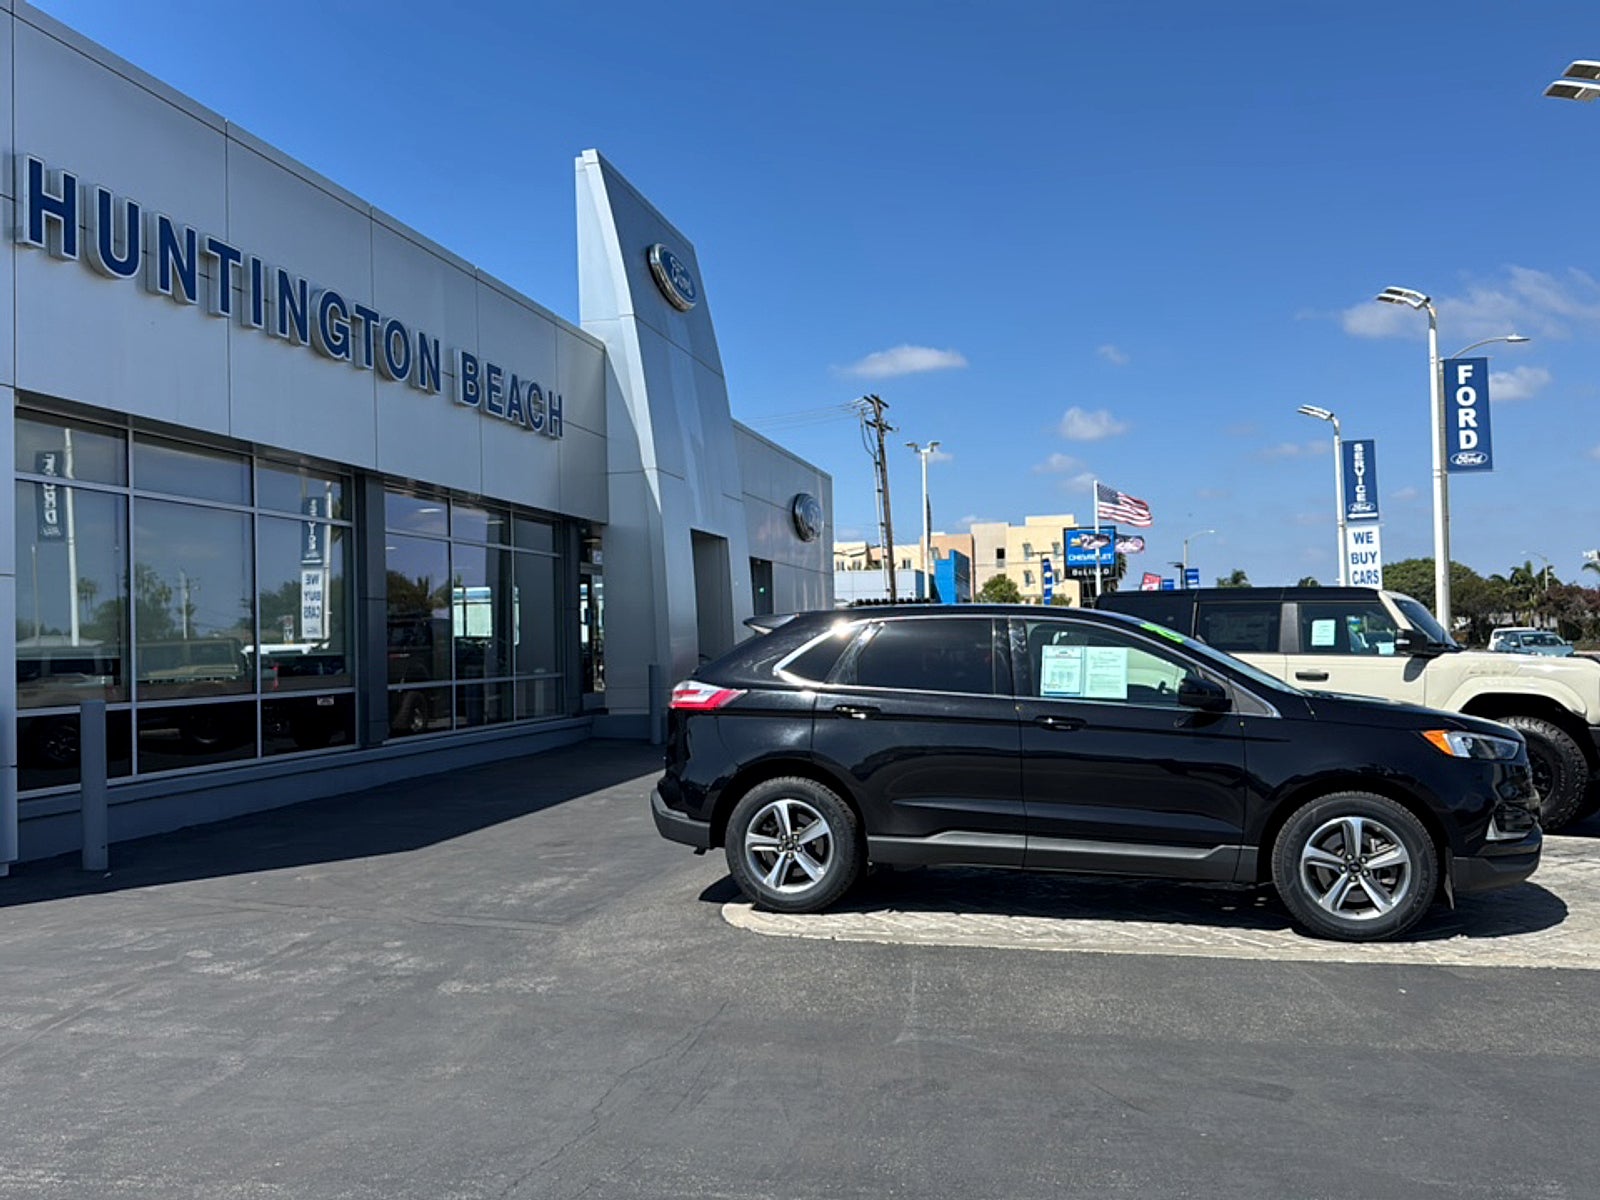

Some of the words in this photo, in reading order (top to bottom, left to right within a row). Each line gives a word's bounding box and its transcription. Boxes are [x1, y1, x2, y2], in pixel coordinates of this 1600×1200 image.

[23, 154, 442, 394] HUNTINGTON
[456, 349, 563, 440] BEACH
[1456, 364, 1479, 450] FORD
[1353, 443, 1367, 502] SERVICE
[1353, 531, 1374, 544] WE
[1068, 553, 1111, 561] CHEVRLET
[1351, 551, 1377, 565] BUY
[1352, 569, 1379, 585] CARS
